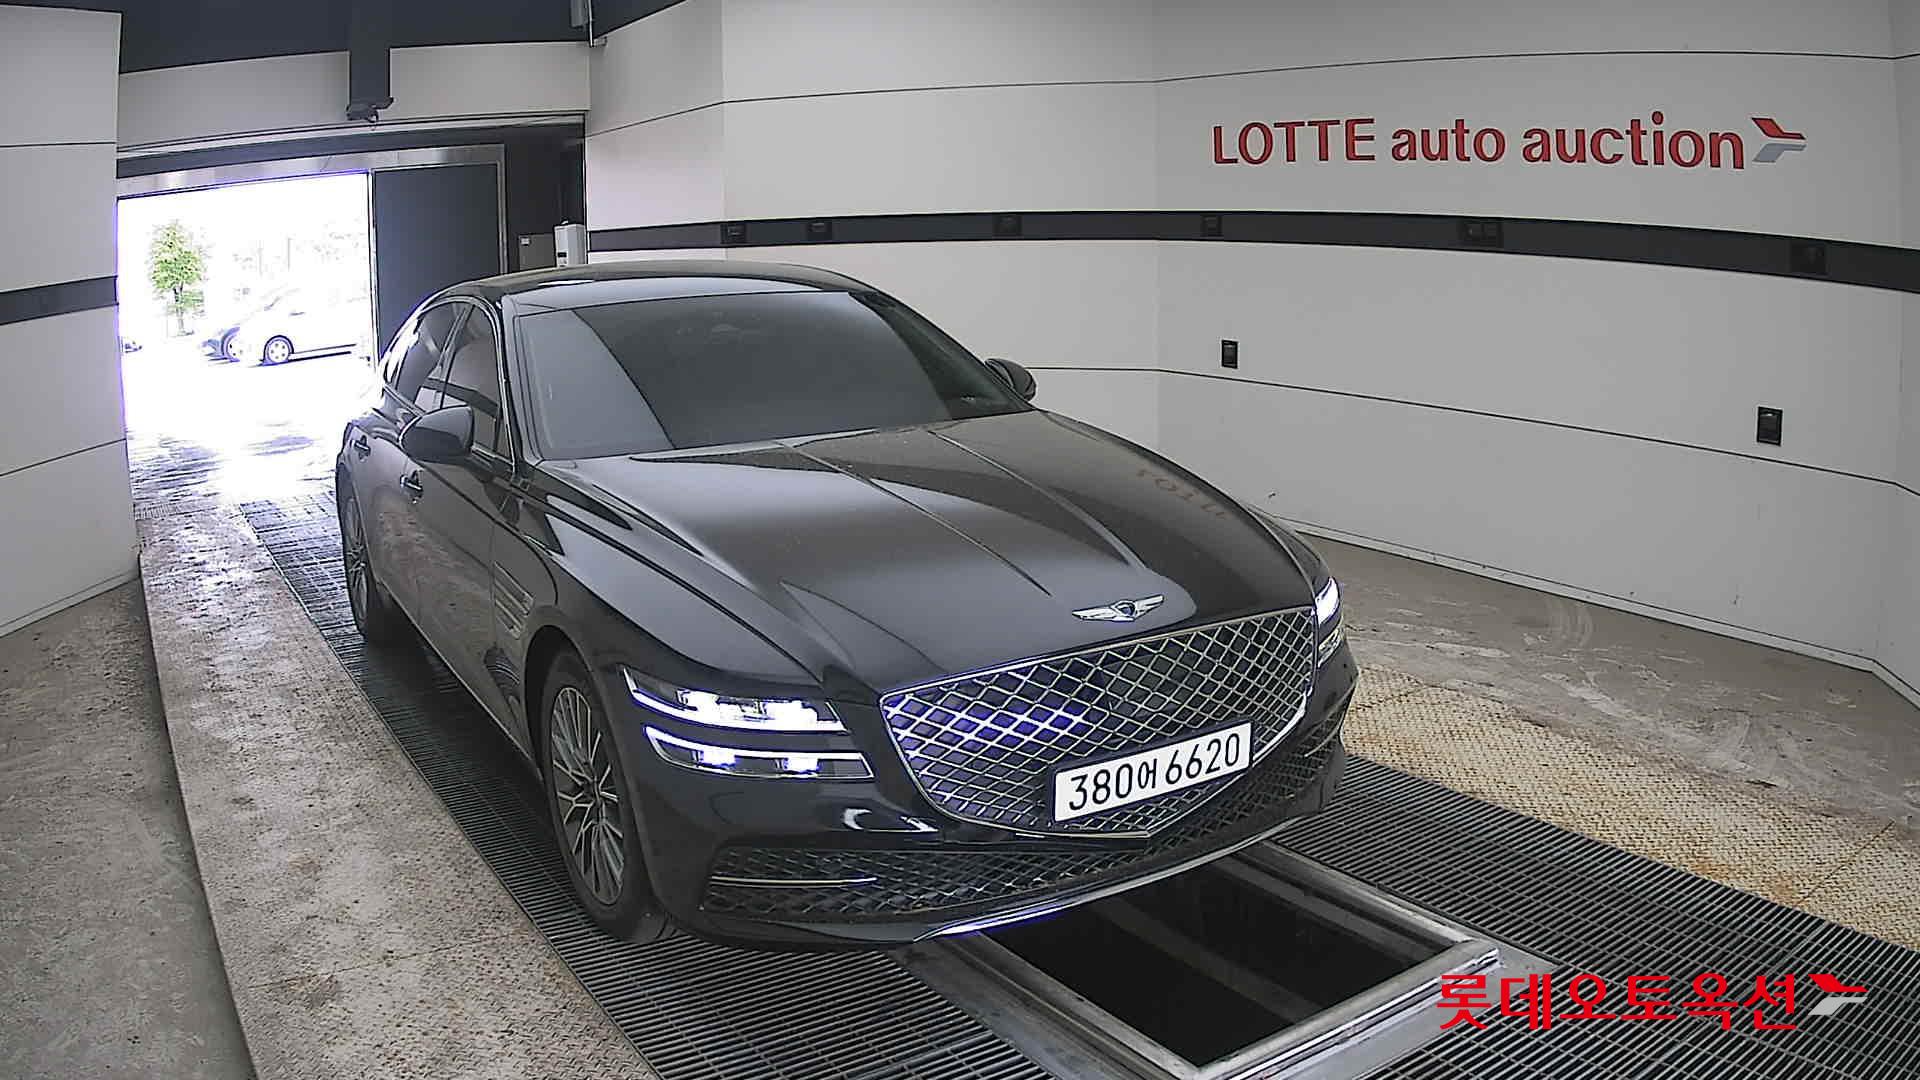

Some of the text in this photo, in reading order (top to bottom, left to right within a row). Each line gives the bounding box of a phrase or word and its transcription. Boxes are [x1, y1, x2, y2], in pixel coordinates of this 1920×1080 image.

[1213, 111, 1745, 170] LOTTE auto auction
[1165, 733, 1240, 785] 6620
